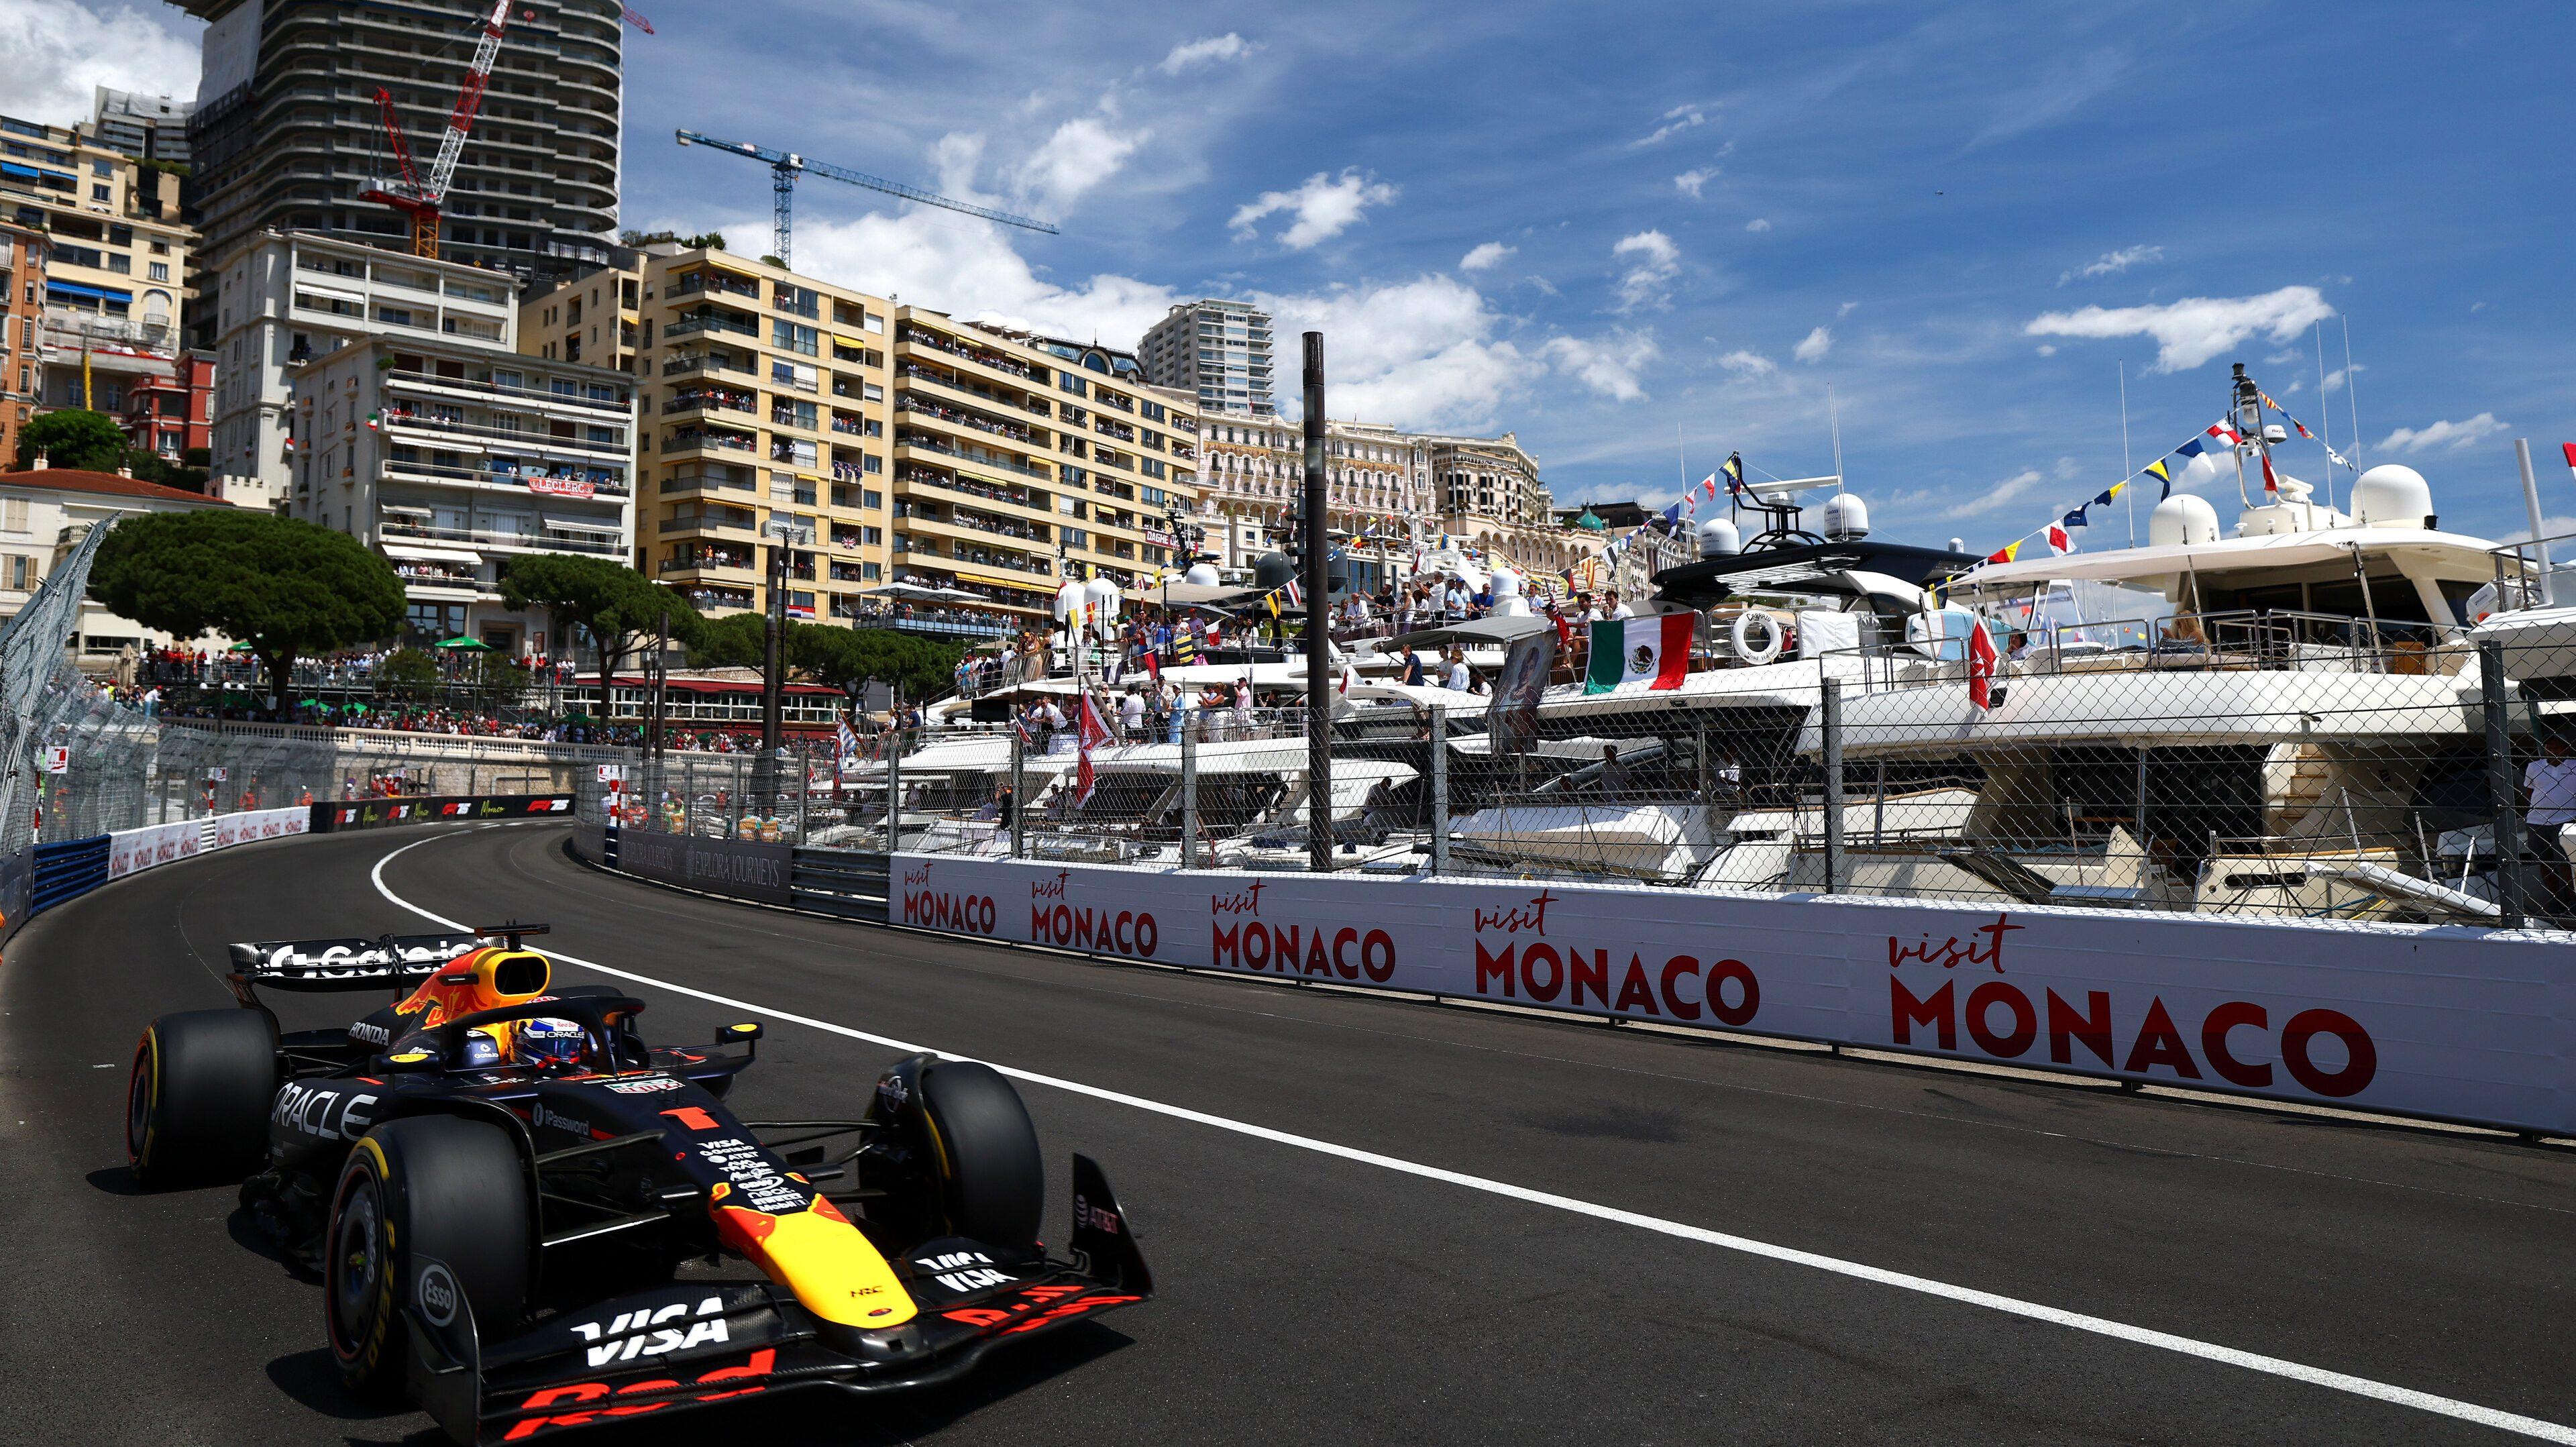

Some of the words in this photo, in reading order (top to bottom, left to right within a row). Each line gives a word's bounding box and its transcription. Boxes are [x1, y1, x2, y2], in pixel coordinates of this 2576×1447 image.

[539, 479, 584, 492] LECLERC
[1147, 531, 1169, 545] DAGHE
[695, 851, 729, 879] EXPLORA
[730, 855, 779, 888] JOURNEYS
[904, 858, 933, 887] visit
[1032, 867, 1071, 900] visit
[904, 890, 996, 935] MONACO
[1212, 877, 1267, 917] visit
[1474, 888, 1559, 936] visit
[1032, 903, 1158, 957] MONACO
[1888, 912, 2025, 974] visit
[1212, 920, 1396, 983] MONACO
[1476, 938, 1760, 1026] MONACO
[349, 1022, 390, 1047] HONDA
[546, 1031, 585, 1039] ORACLE
[1890, 973, 2377, 1097] MONACO
[271, 1082, 378, 1141] ORACLE
[545, 1109, 590, 1136] 1Password
[658, 1106, 720, 1130] 1
[696, 1138, 745, 1149] VISA
[425, 1278, 452, 1310] Esso
[570, 1297, 730, 1366] VISA
